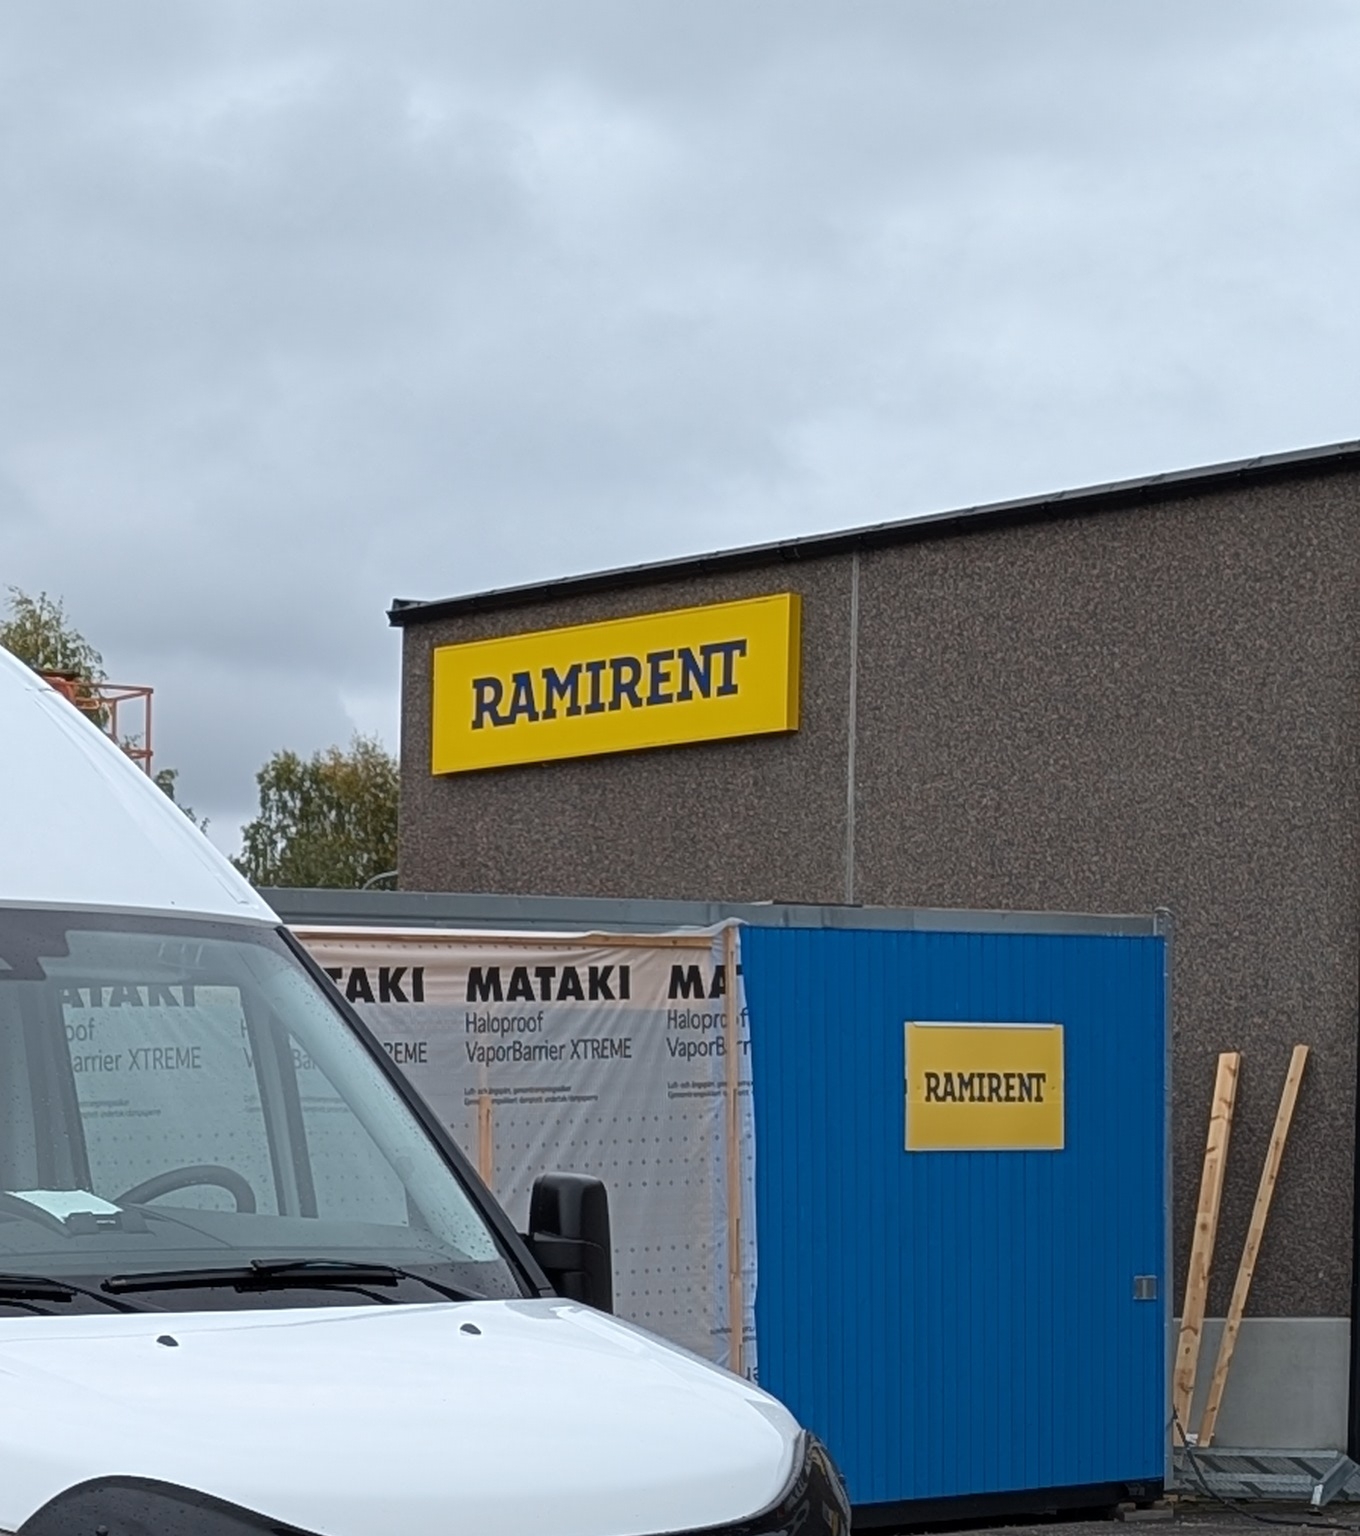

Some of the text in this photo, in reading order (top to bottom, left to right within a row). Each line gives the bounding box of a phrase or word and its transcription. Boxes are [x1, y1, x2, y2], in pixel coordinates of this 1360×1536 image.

[471, 639, 747, 730] RAMIRENT
[466, 965, 630, 1002] MATAKI
[465, 1011, 544, 1037] Haloproof
[128, 1046, 202, 1071] XTREME
[465, 1038, 632, 1067] VaporBarrier XTREME
[924, 1072, 1047, 1103] RAMIRENT
